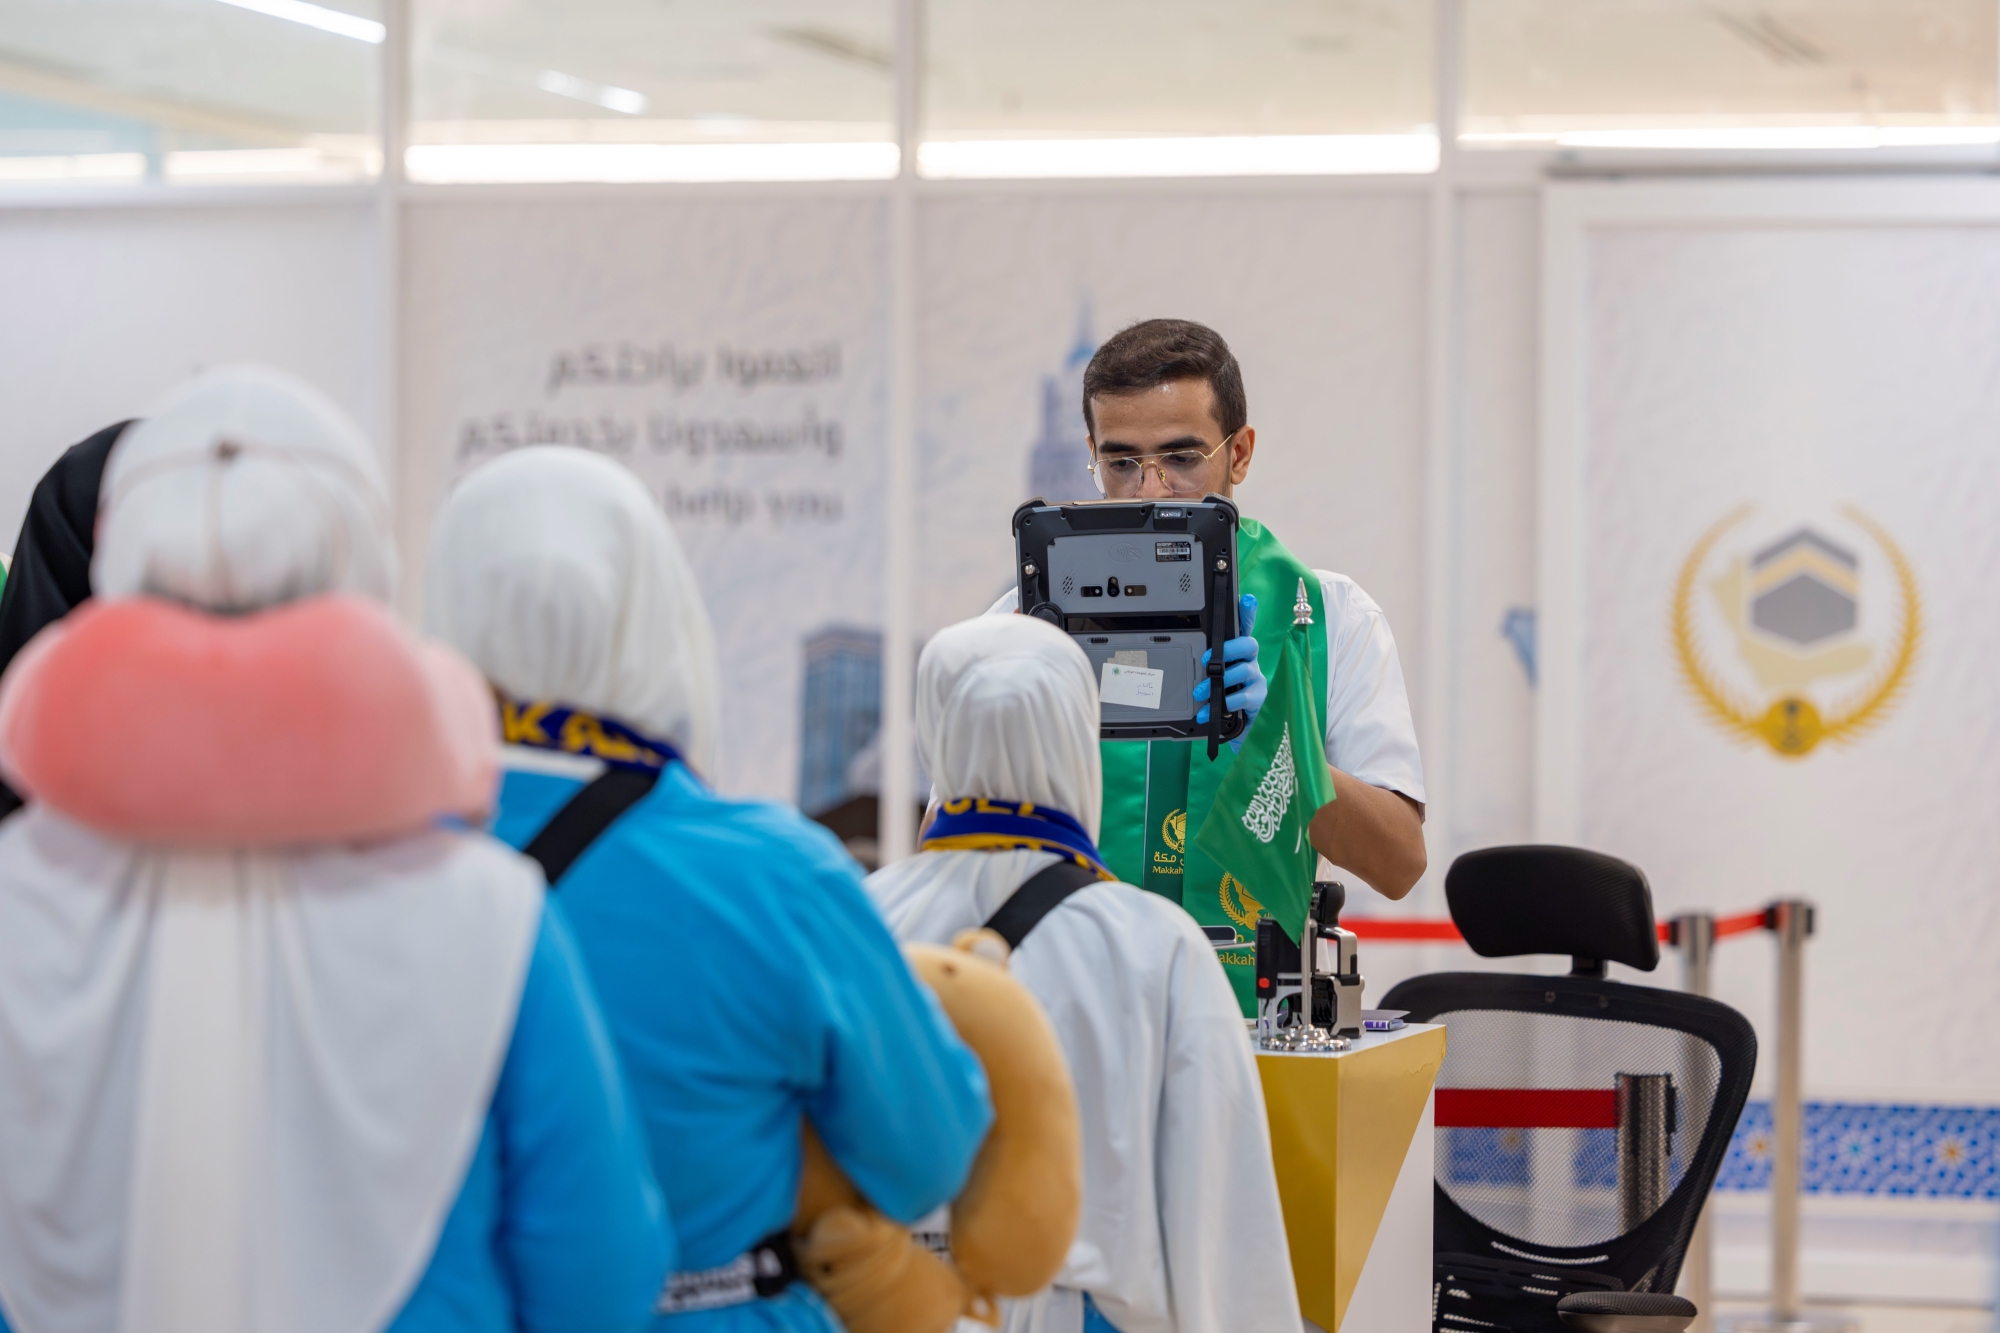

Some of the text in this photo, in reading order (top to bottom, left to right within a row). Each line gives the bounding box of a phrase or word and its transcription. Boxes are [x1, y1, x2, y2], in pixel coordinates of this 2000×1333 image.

[1153, 850, 1177, 863] مكة
[1152, 865, 1184, 875] Makkah
[1217, 951, 1255, 966] akkah
